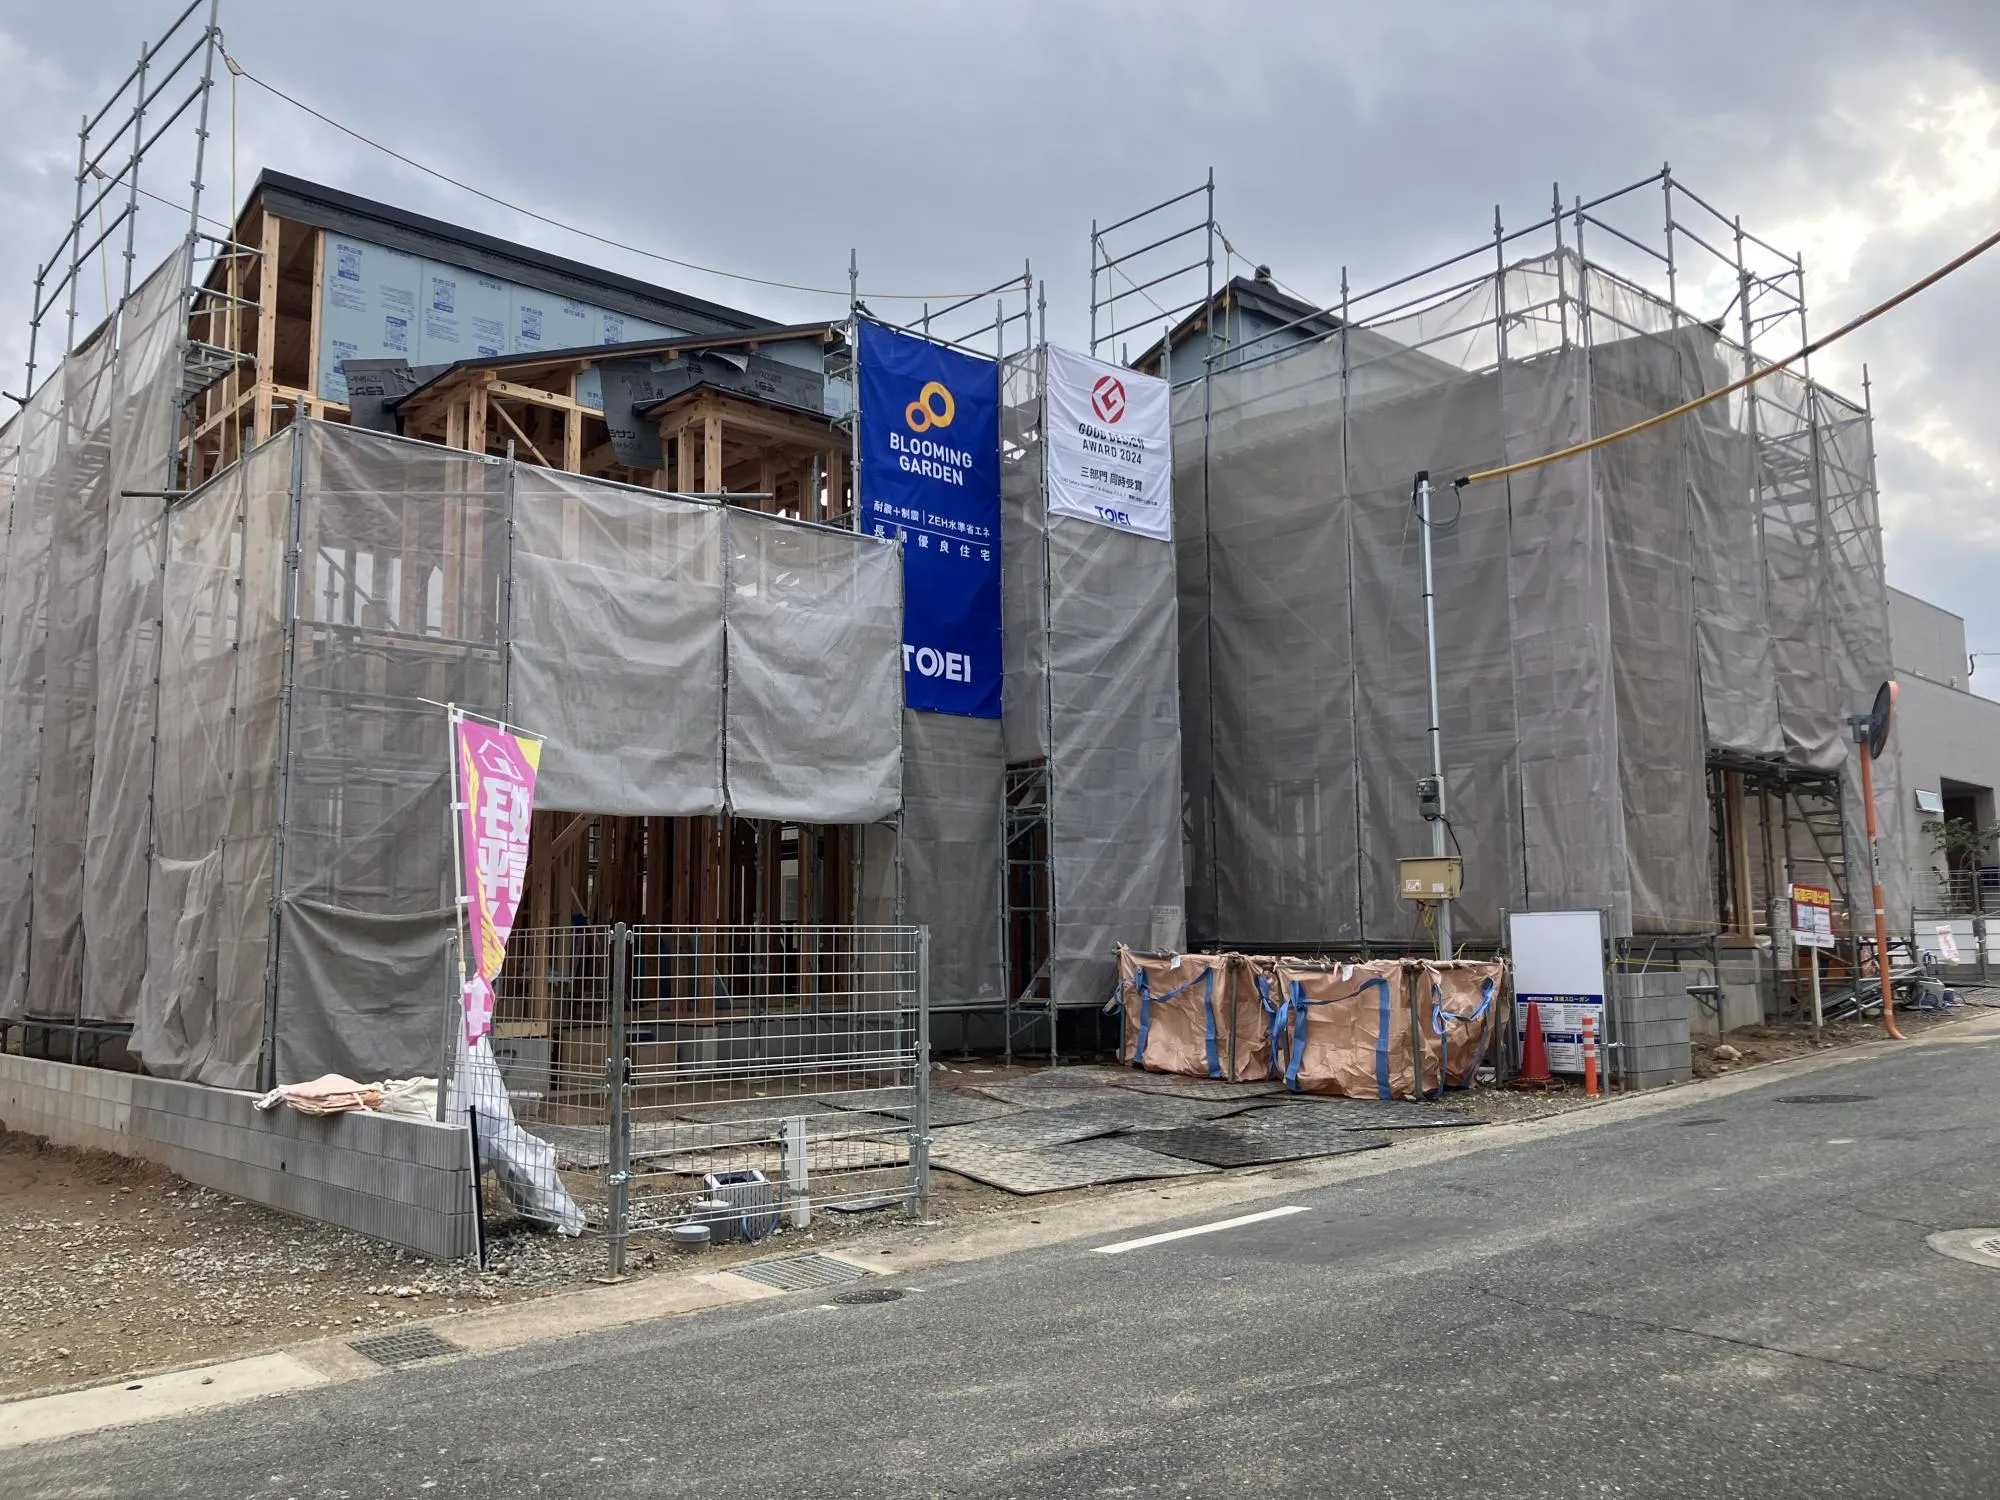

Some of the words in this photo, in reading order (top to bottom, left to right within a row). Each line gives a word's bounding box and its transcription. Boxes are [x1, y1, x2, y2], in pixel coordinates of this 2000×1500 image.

[890, 432, 973, 469] BLOOMING
[1082, 439, 1117, 458] AWARD
[1120, 449, 1142, 465] 2024
[899, 456, 963, 487] GARDEN
[1080, 466, 1108, 483] 三部門
[1109, 473, 1143, 492] 同時受賞
